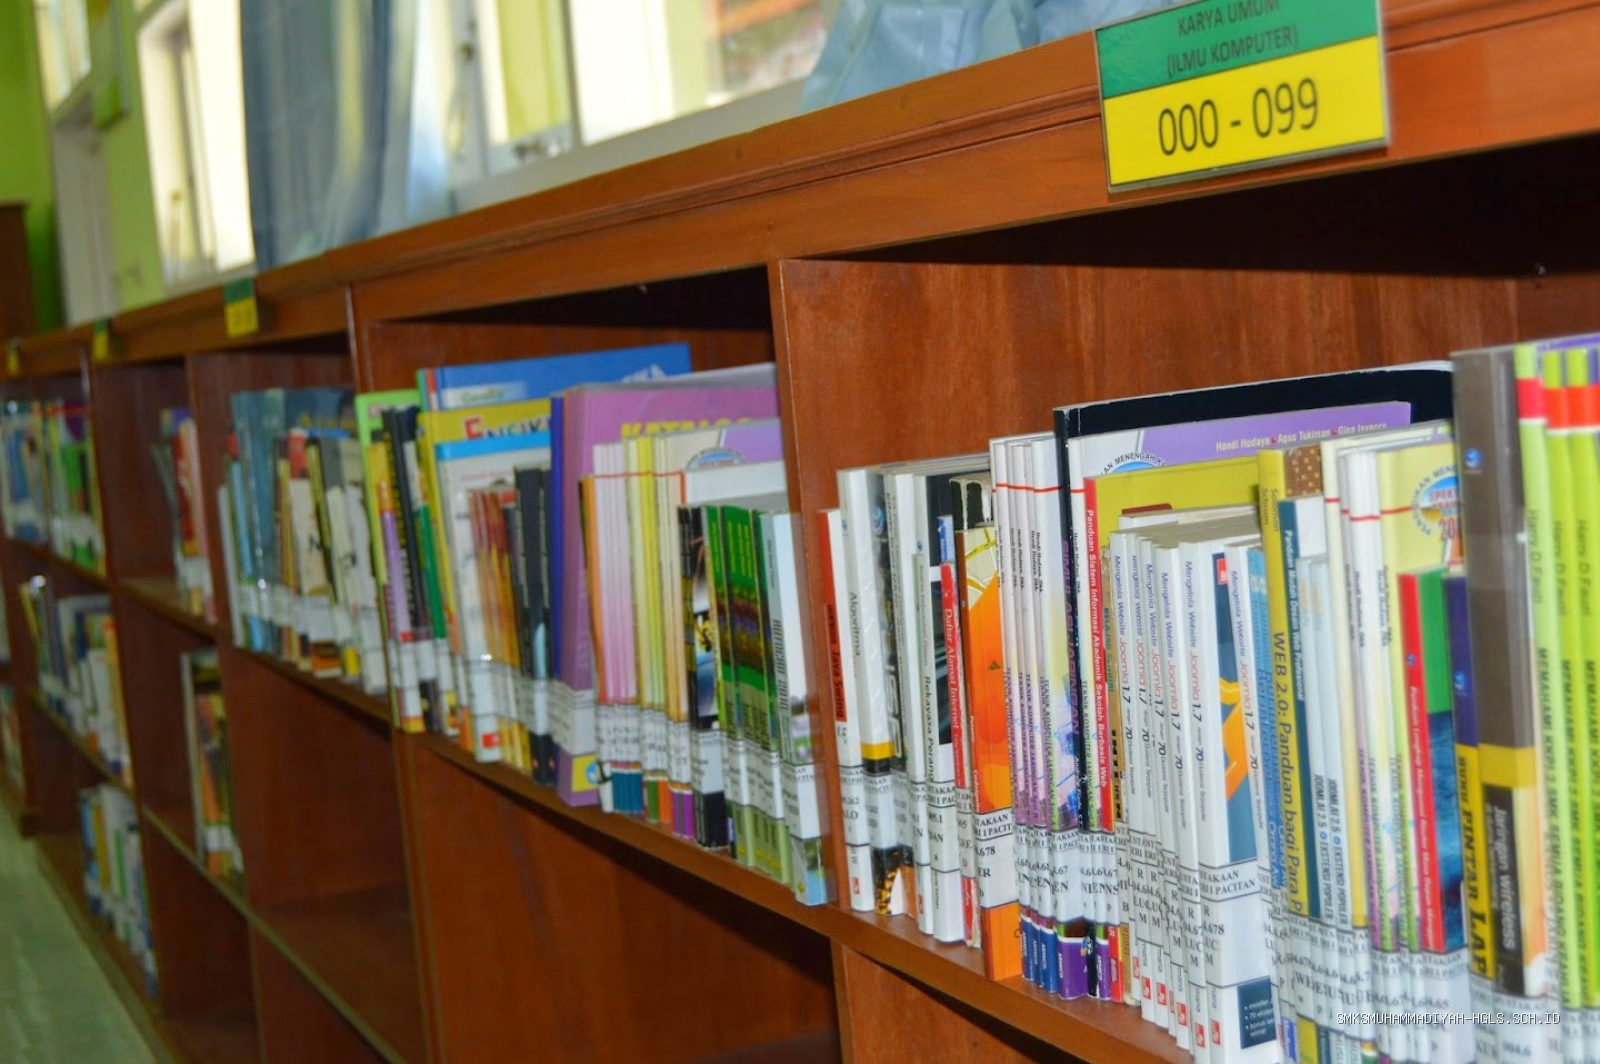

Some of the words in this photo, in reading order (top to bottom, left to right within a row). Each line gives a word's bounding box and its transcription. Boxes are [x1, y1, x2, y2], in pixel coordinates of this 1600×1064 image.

[1177, 11, 1223, 37] KARYA
[1228, 0, 1281, 23] UMUM
[1167, 51, 1207, 78] (ILMU
[1210, 24, 1299, 63] KOMPUTER)
[1158, 99, 1219, 156] 000
[1230, 120, 1242, 128] -
[1252, 78, 1319, 138] 099
[464, 417, 550, 441] ENSIK
[1240, 436, 1270, 450] Hudaya
[1278, 433, 1297, 445] Agus
[1299, 428, 1331, 441] Tukiman
[1087, 510, 1095, 551] Panduan
[1284, 530, 1294, 568] Panduan
[1089, 554, 1097, 587] Sistem
[1114, 556, 1122, 599] Mengelola
[1186, 561, 1194, 608] Mengelola
[1288, 570, 1297, 599] Mudah
[1091, 588, 1100, 635] Informasi
[1161, 572, 1170, 619] Mengelola
[1231, 571, 1241, 619] Mengelola
[849, 592, 861, 656] Algoritma
[945, 608, 954, 642] Daftar
[1117, 602, 1125, 635] Website
[1188, 611, 1196, 648] Website
[1290, 601, 1298, 630] Desain
[1165, 621, 1173, 658] Website
[1237, 620, 1246, 656] Website
[1274, 632, 1286, 676] WEB
[947, 647, 957, 685] Alamat
[1093, 636, 1103, 684] Akademik
[1119, 638, 1130, 688] Joomla
[1152, 651, 1162, 700] Joomla
[1190, 652, 1200, 704] Joomla
[1096, 685, 1104, 724] Sekolah
[1122, 686, 1131, 703] 1.7
[1167, 661, 1178, 712] Joomla
[1240, 660, 1251, 711] Joomla
[1277, 683, 1290, 718] 2.0:
[1538, 648, 1553, 730] MEMAHAMI
[1561, 660, 1575, 743] MEMAHAMI
[924, 676, 933, 735] Rekayasa
[950, 687, 961, 729] Internet
[1155, 701, 1163, 717] 1.7
[1171, 712, 1181, 731] 1.7
[1192, 704, 1202, 722] 1.7
[1244, 711, 1254, 731] 1.7
[1409, 686, 1420, 725] Panduan
[1098, 724, 1106, 766] Berbasis
[1126, 727, 1133, 740] 70
[1159, 742, 1166, 755] 70
[926, 738, 935, 782] Perang
[1175, 755, 1183, 769] 70
[1196, 747, 1204, 761] 70
[1250, 755, 1258, 770] 70
[1280, 722, 1295, 805] Panduan
[1100, 766, 1108, 787] Web
[1459, 757, 1469, 806] BUKU
[1318, 813, 1327, 827] 2.5
[1548, 788, 1560, 818] SMK
[1569, 799, 1581, 831] SMK
[988, 823, 1011, 836] PACIT
[1268, 821, 1279, 861] Orang
[1285, 809, 1298, 851] bagi
[1331, 818, 1341, 832] 2.5
[1495, 806, 1509, 871] Jaringan
[1319, 841, 1331, 881] EKSTENSI
[1333, 846, 1345, 886] EKSTENSI
[1463, 810, 1479, 900] PINTAR
[1550, 824, 1563, 875] SEMUA
[1572, 838, 1585, 888] SEMUA
[1137, 868, 1144, 879] R
[1150, 871, 1157, 881] R
[1215, 878, 1256, 896] PACITAN
[1288, 852, 1301, 895] Para
[1188, 907, 1195, 919] R
[1203, 904, 1210, 917] R
[1293, 900, 1303, 912] P
[1323, 883, 1334, 919] POPULER
[1337, 887, 1348, 925] POPULER
[1470, 910, 1487, 973] LAP
[1558, 941, 1571, 1004] KEAHLIA
